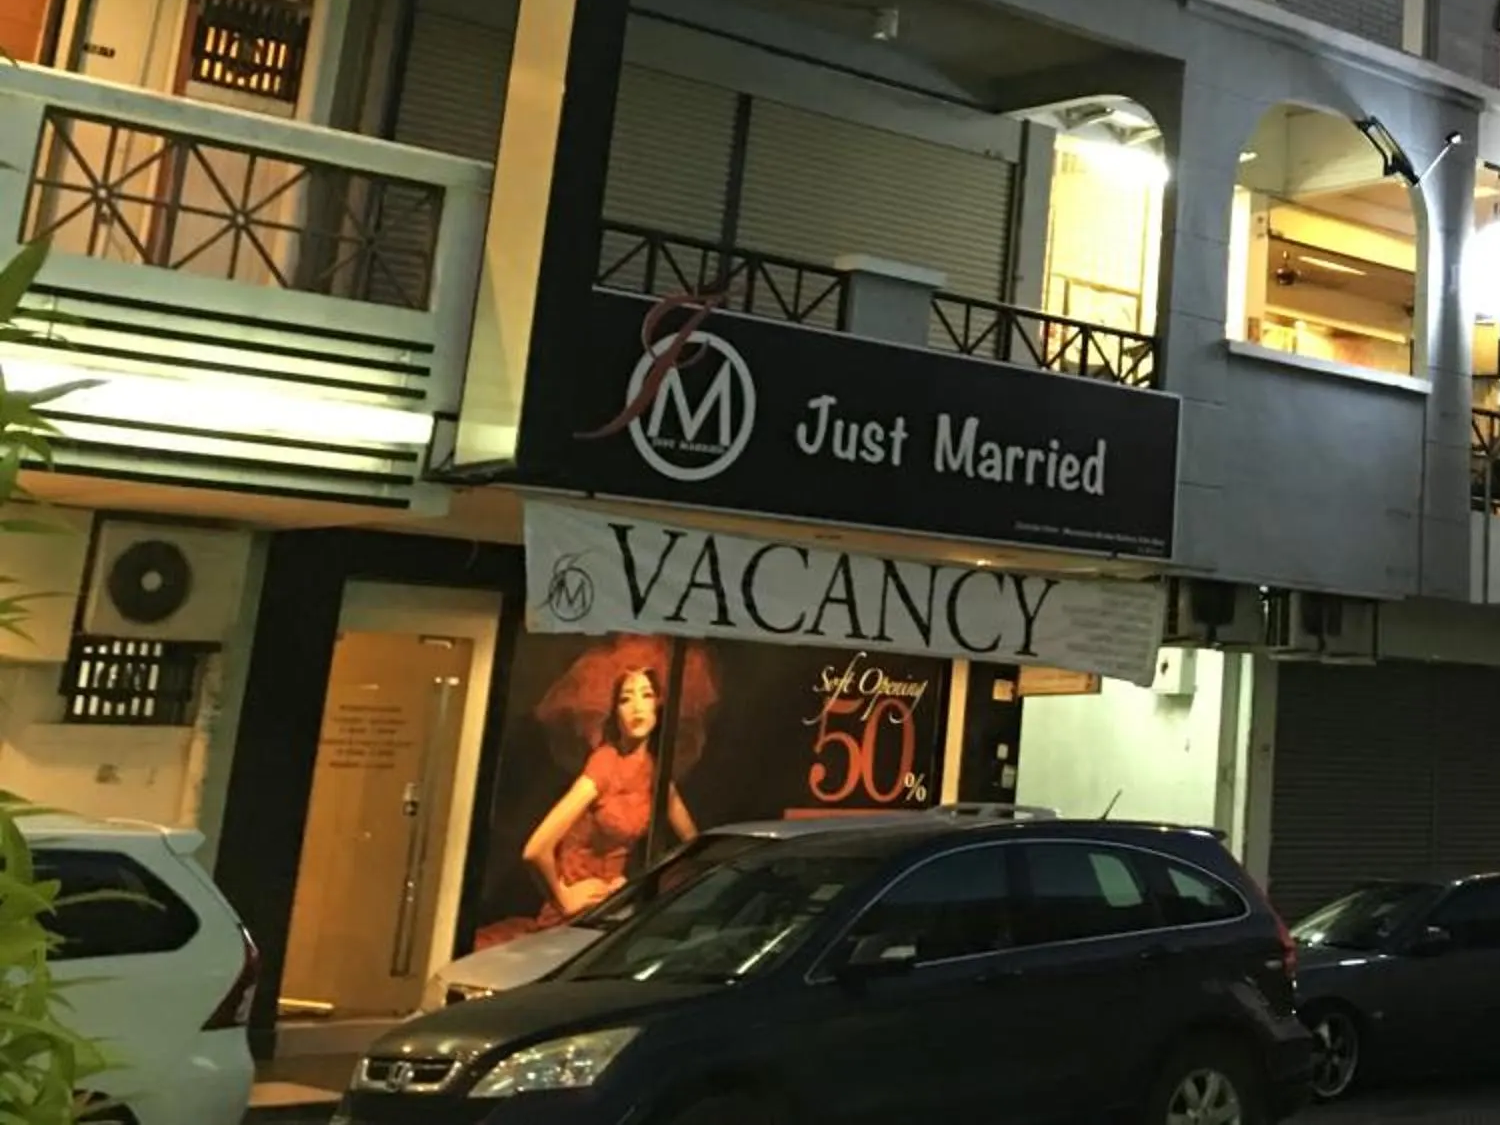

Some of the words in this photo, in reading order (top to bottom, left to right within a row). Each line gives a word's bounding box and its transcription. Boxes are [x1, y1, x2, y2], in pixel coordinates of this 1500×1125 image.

[796, 394, 909, 467] Just
[934, 413, 1105, 496] Married
[607, 522, 1060, 657] VACANCY
[803, 652, 868, 725] Soft
[858, 668, 929, 724] Opening
